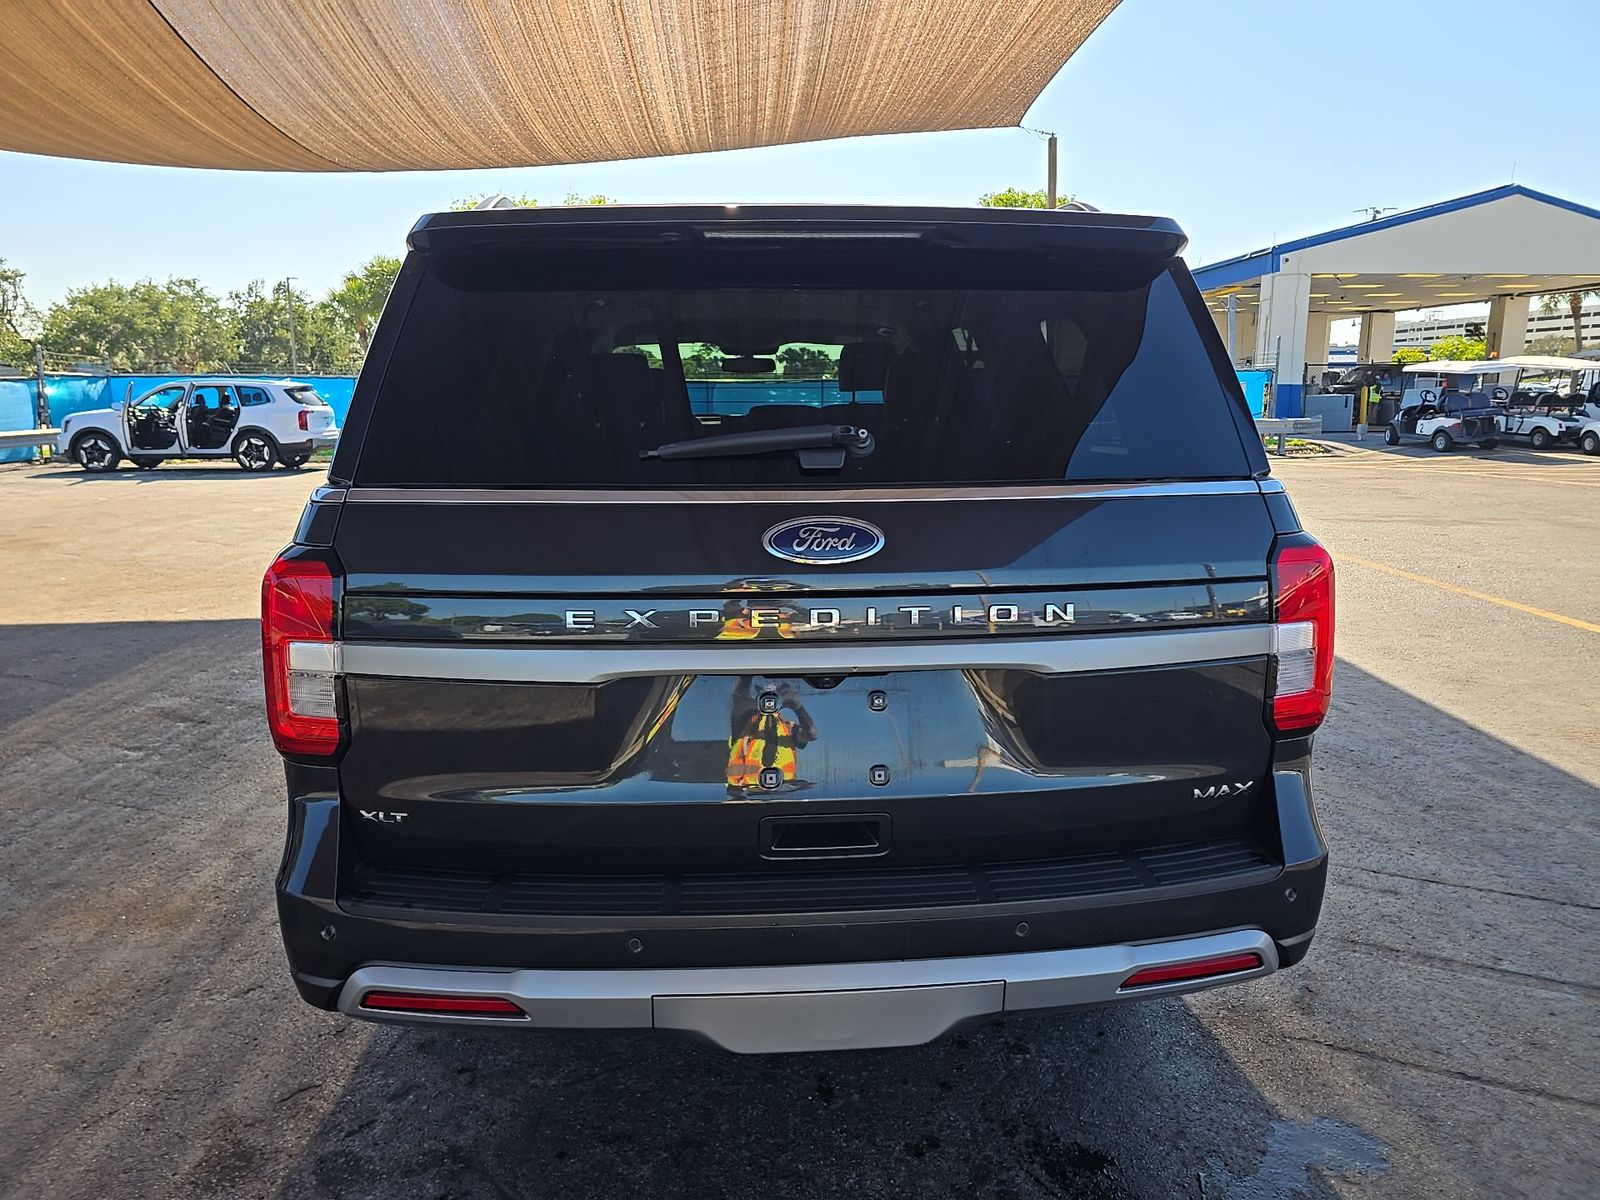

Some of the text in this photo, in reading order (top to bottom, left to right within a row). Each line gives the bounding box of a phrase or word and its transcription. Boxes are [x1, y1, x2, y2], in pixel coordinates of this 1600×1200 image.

[792, 526, 857, 552] Ford
[565, 603, 1075, 629] EXPEDITION
[1193, 780, 1254, 799] MAX
[359, 809, 409, 823] XLT
